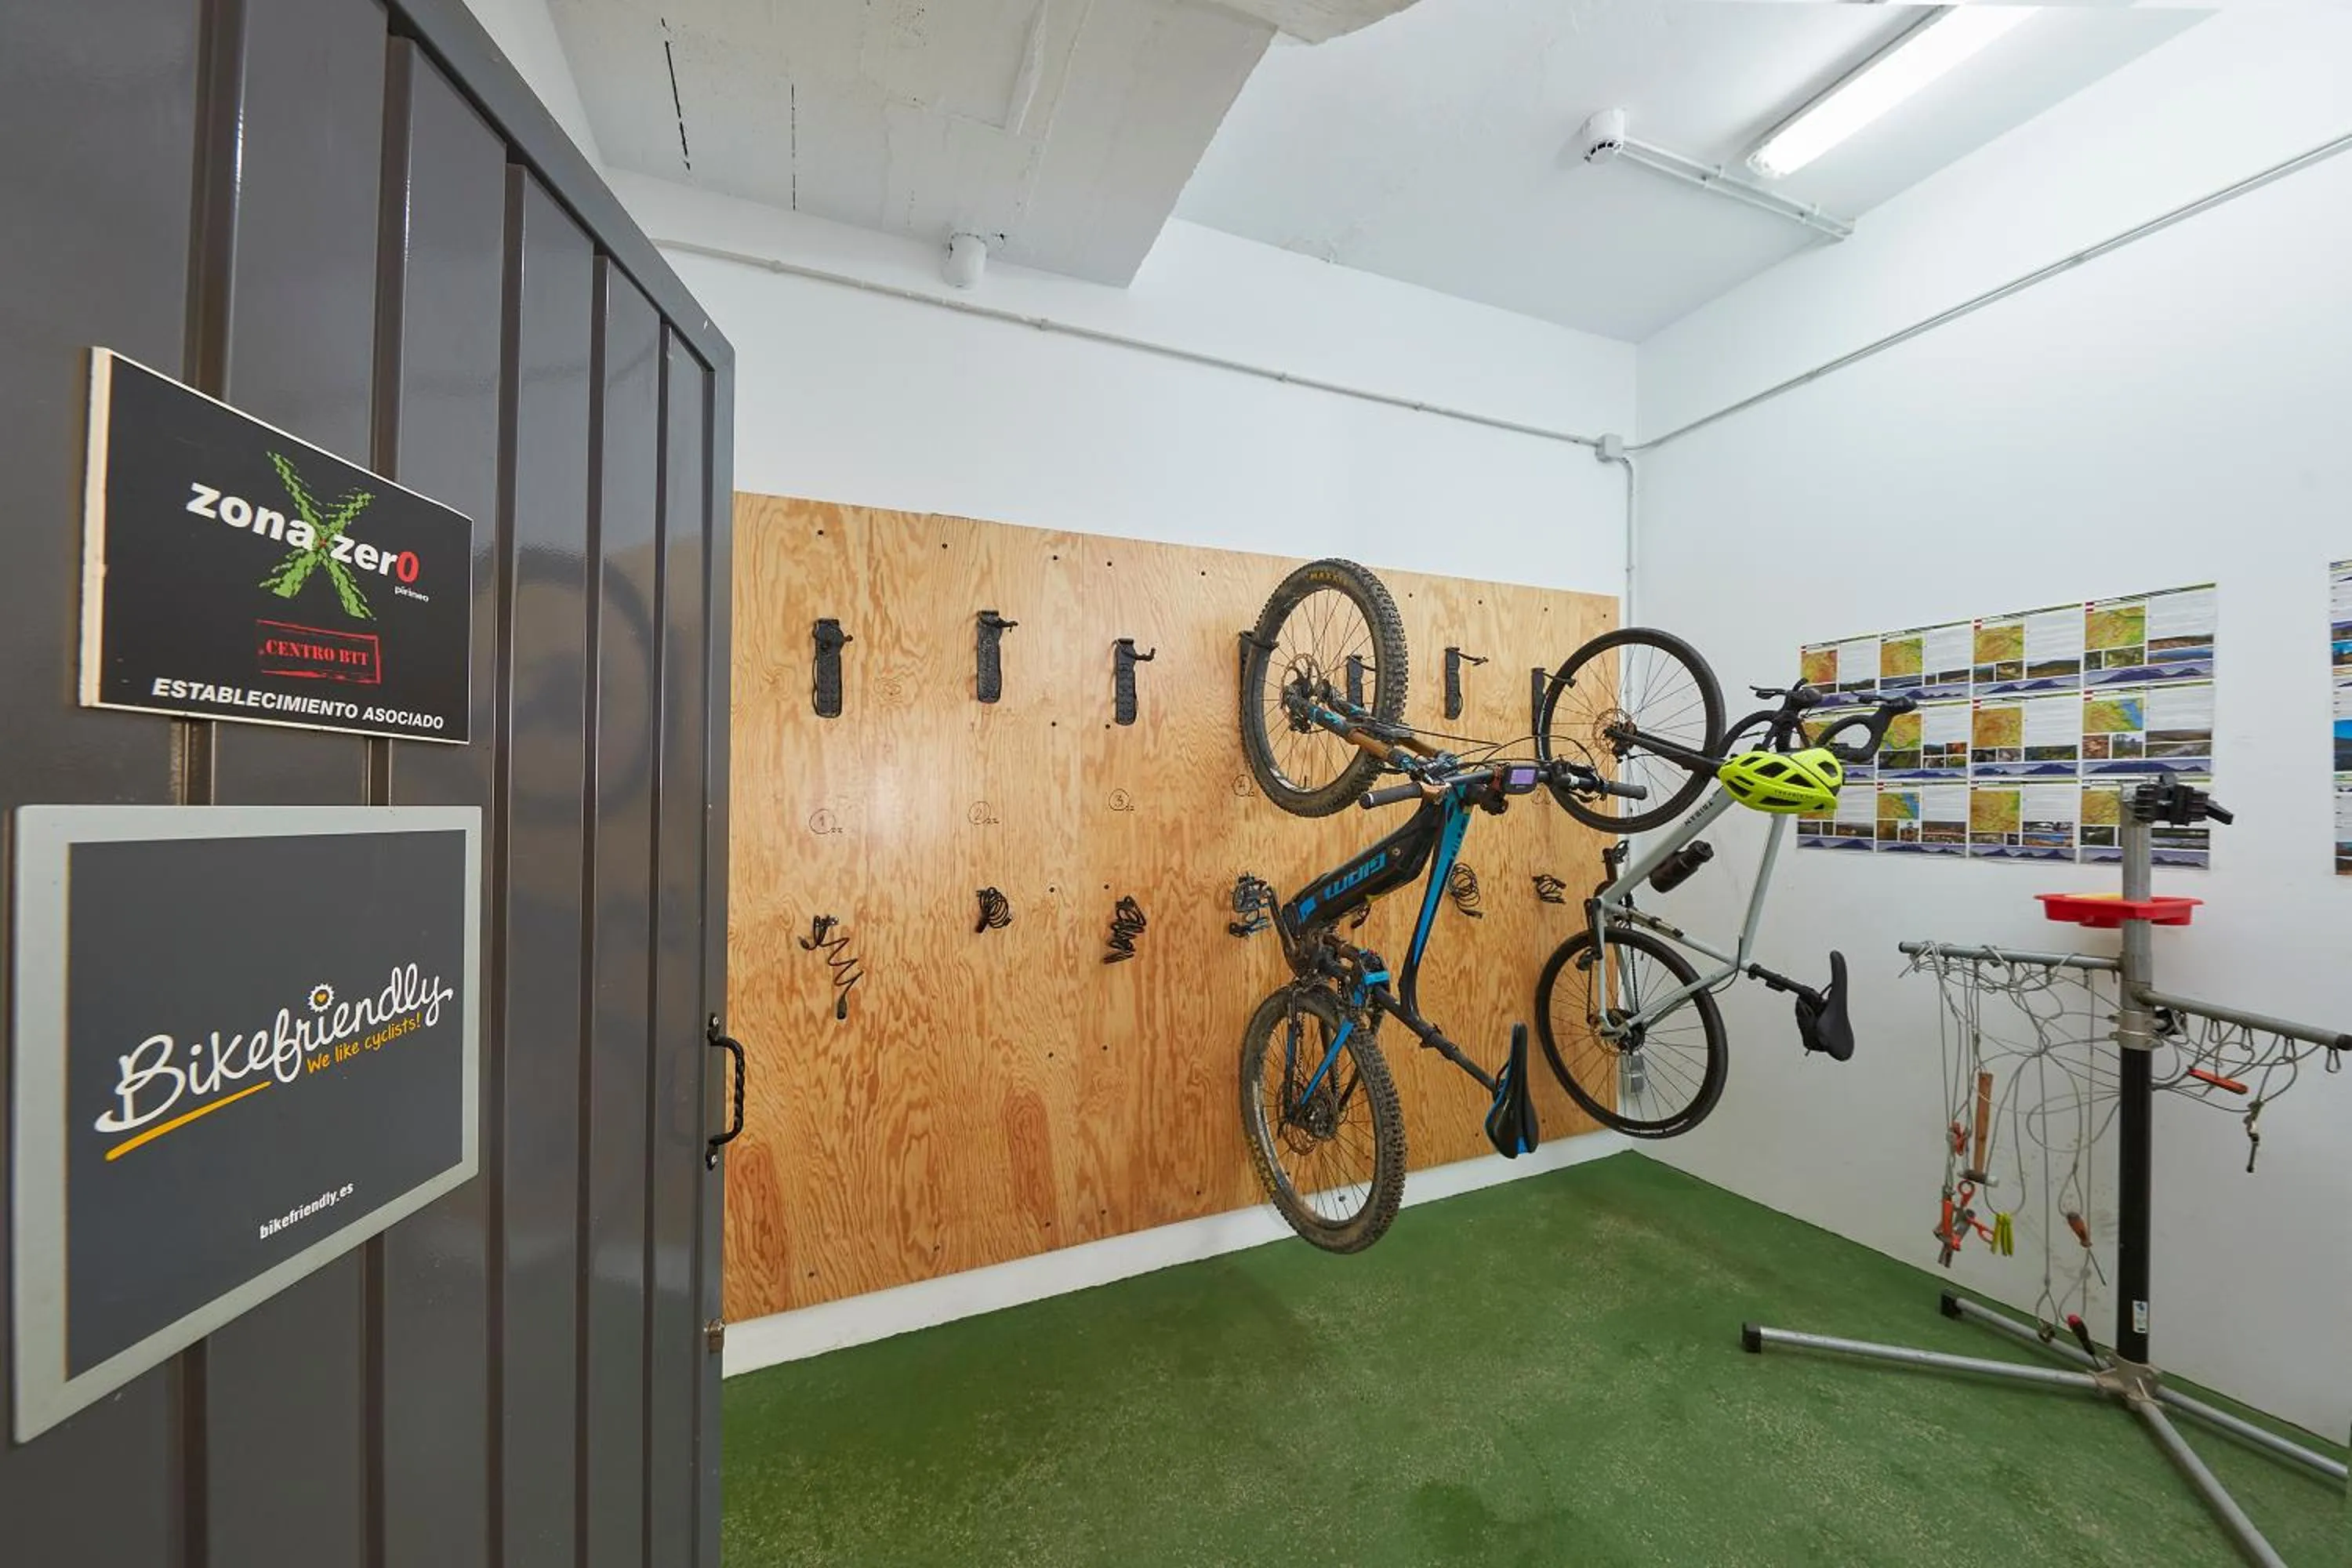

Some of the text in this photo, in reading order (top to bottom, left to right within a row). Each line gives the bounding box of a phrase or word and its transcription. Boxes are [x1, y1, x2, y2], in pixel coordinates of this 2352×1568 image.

[186, 482, 316, 551] zona
[394, 585, 429, 603] pirineo
[265, 637, 370, 666] CENTRO BTT
[151, 677, 445, 731] ESTABLECIMIENTO ASOCIADO
[93, 963, 454, 1133] Bikefriendly
[306, 1011, 422, 1074] We like cyclists!
[260, 1182, 354, 1240] bikefriendly.es
